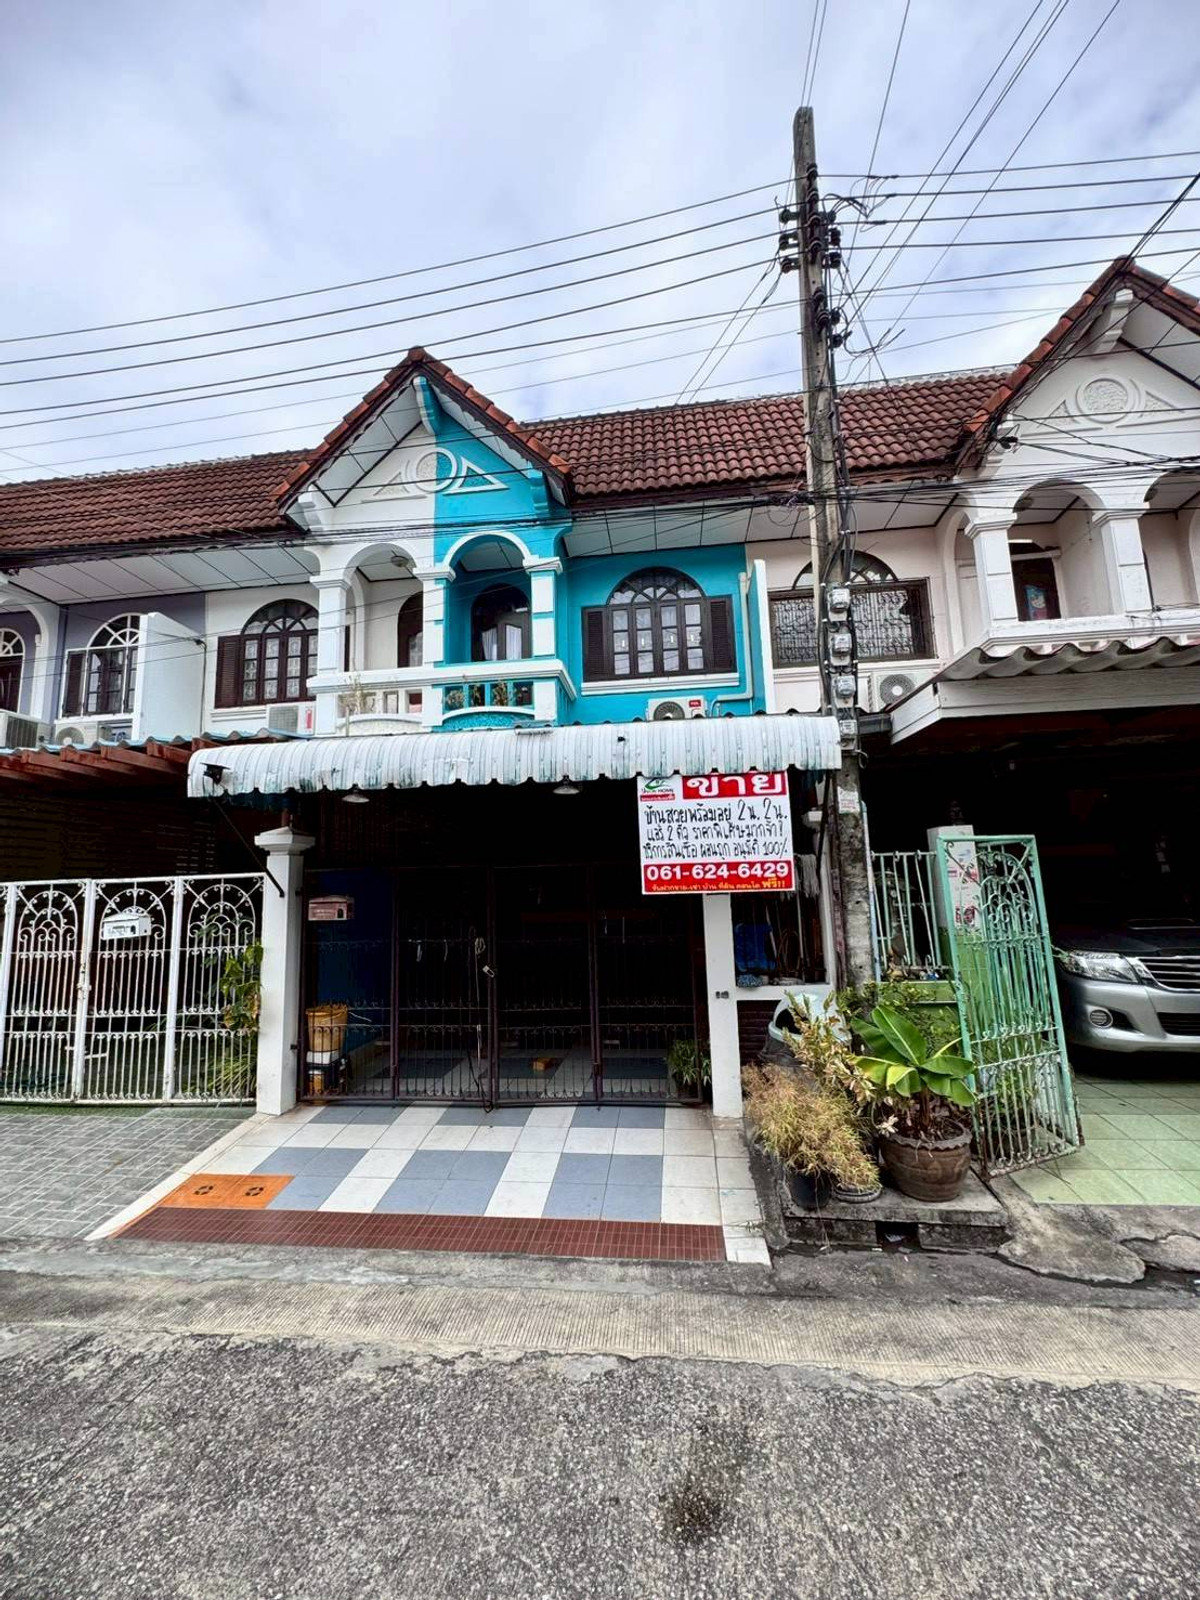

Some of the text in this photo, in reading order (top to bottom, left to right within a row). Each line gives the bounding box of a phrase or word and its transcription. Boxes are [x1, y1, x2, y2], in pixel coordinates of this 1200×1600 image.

[686, 774, 783, 797] ขาย
[667, 825, 674, 841] 2
[762, 838, 788, 859] 100%
[646, 862, 789, 881] 061-624-6429
